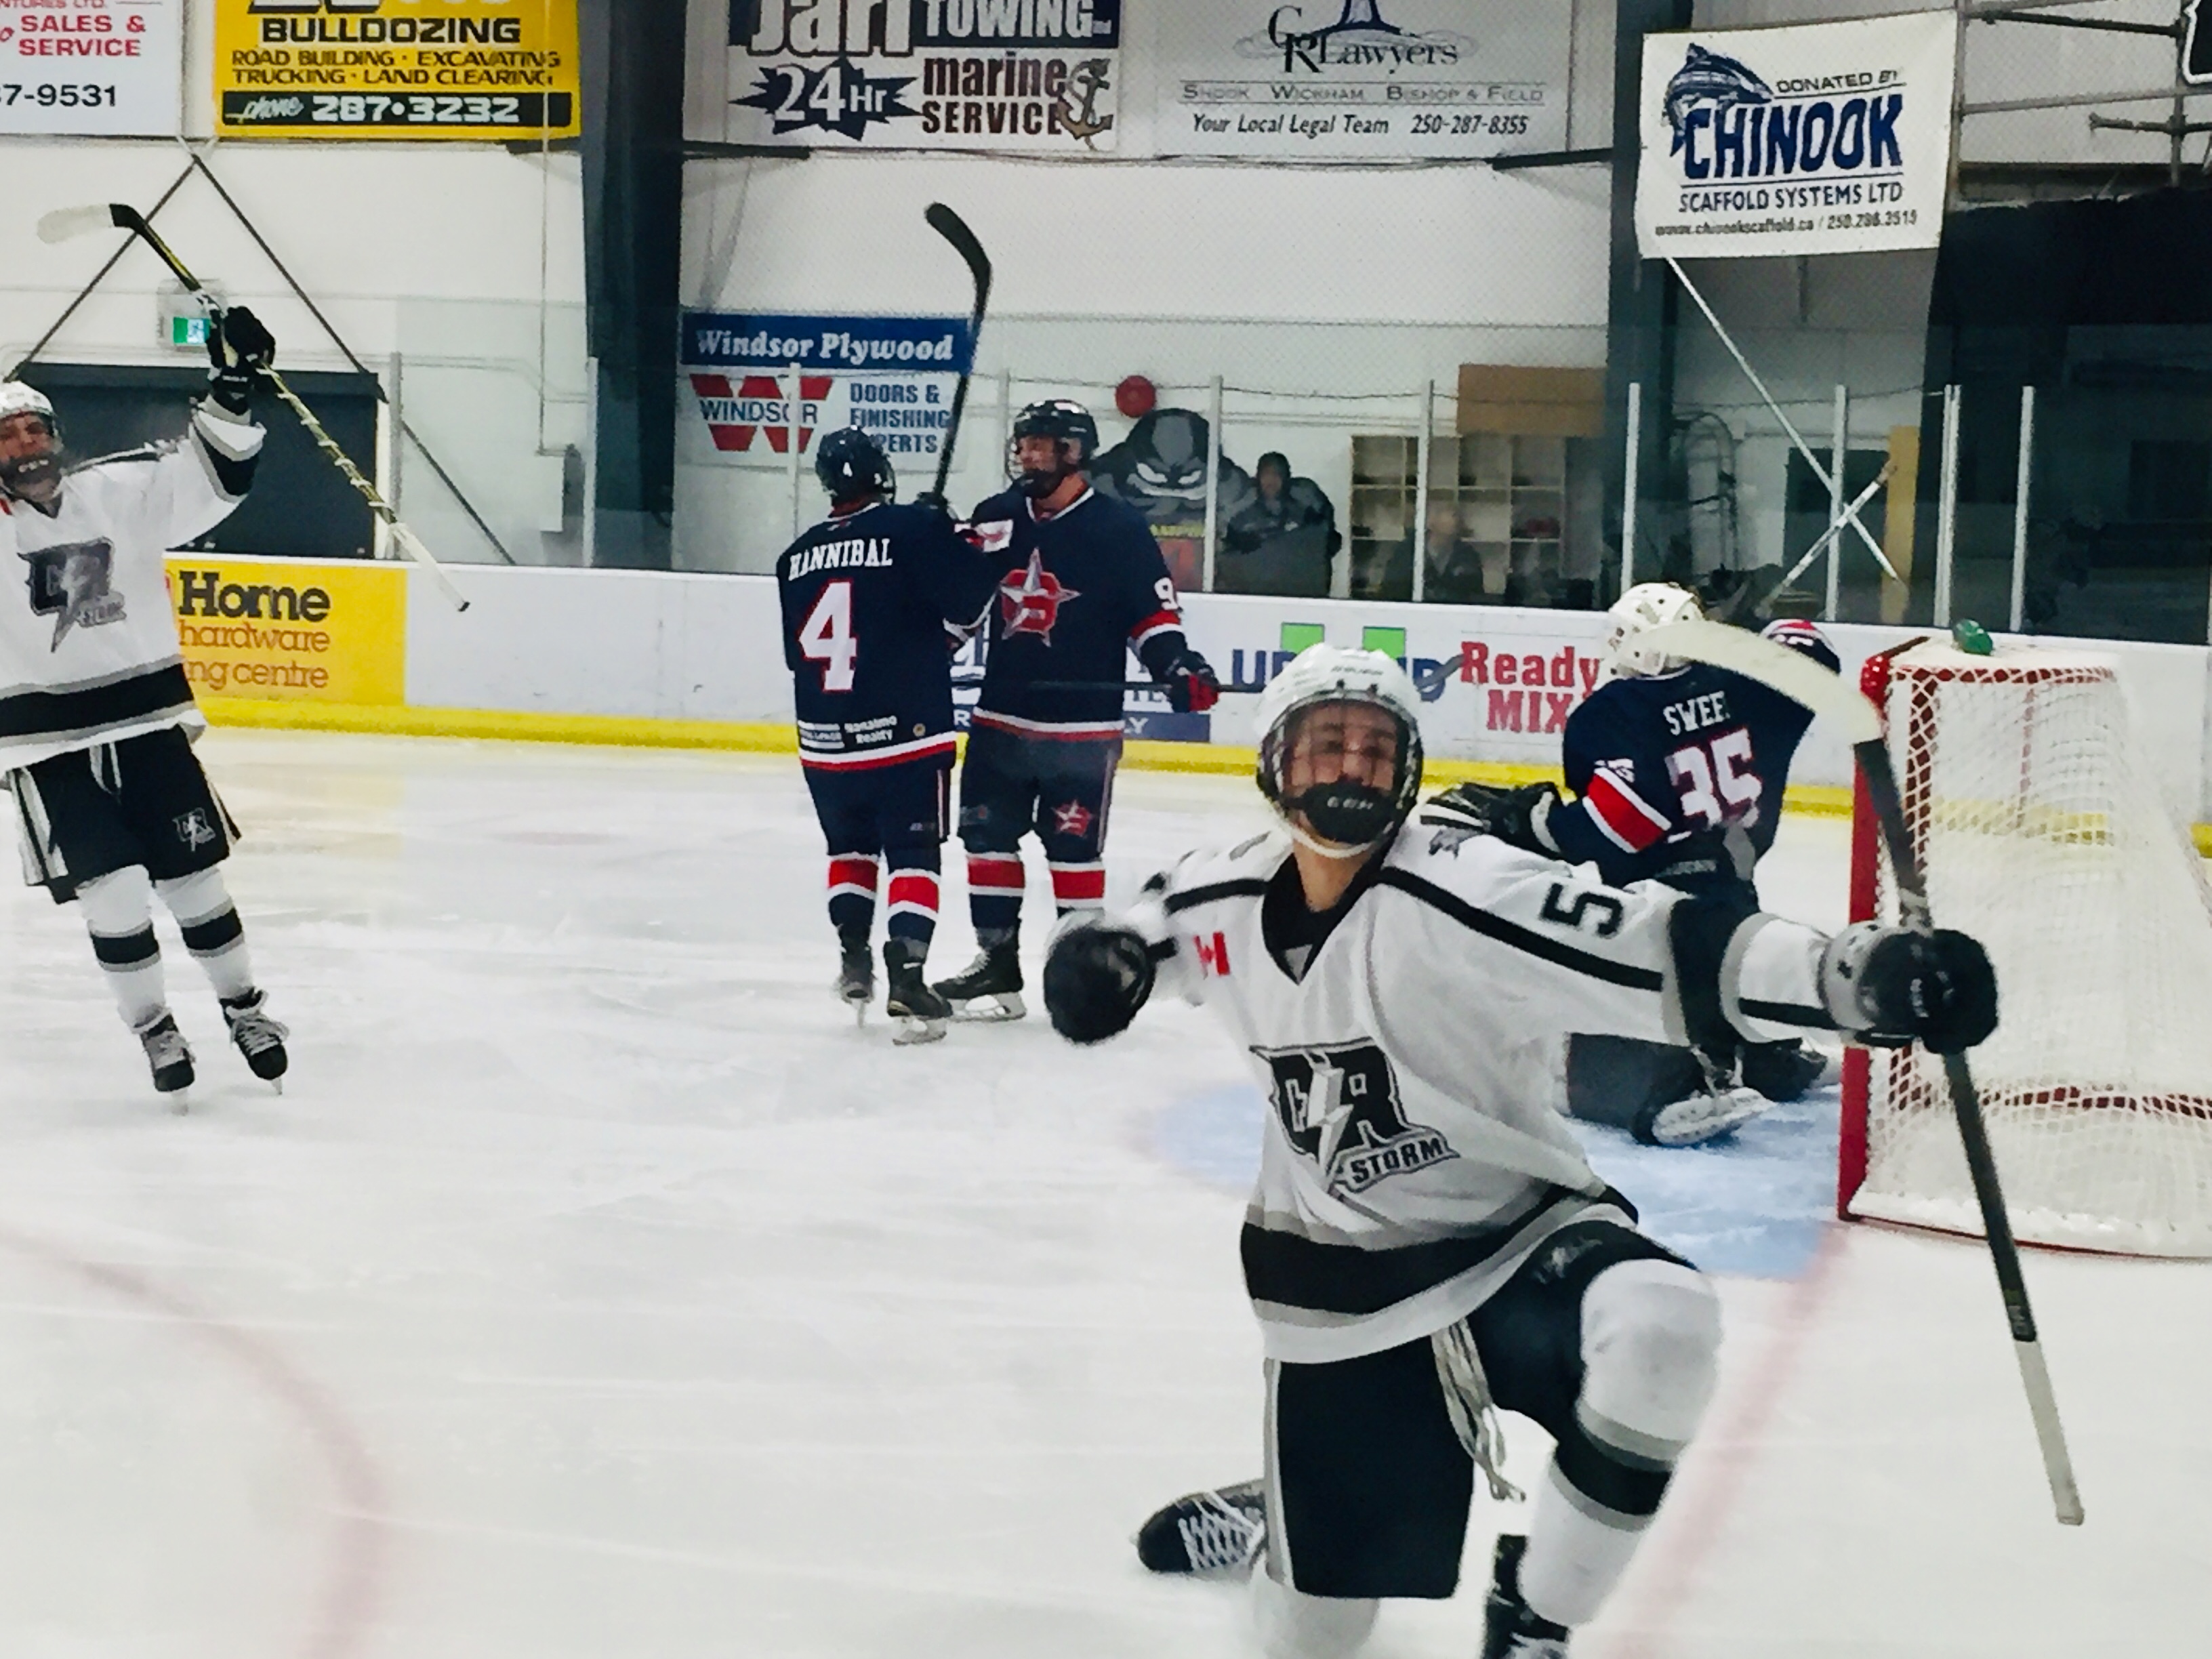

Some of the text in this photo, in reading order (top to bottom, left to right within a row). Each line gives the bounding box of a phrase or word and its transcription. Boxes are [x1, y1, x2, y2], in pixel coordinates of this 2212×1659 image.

[20, 15, 146, 33] SALES &
[262, 18, 520, 43] BULLDOZING
[18, 38, 142, 56] SERVICE
[232, 49, 560, 67] ROAD BUILDING EXCAVATING
[232, 68, 553, 85] TRUCKING LAND CLEARING
[922, 51, 1067, 98] marine
[1776, 72, 1872, 93] DONATED
[0, 83, 116, 107] 7-9531
[775, 65, 846, 121] 24
[922, 100, 1062, 135] SERVICE
[1193, 113, 1231, 131] Your
[1237, 114, 1284, 133] Local
[1289, 114, 1336, 139] Legal
[1343, 114, 1389, 134] Team
[1683, 94, 1904, 180] CHINOOK
[1678, 181, 1904, 213] SCAFFOLD SYSTEMS LTD
[696, 330, 954, 366] Windsor Plywood
[850, 382, 941, 404] DOORS &
[699, 400, 818, 424] WINDSR
[850, 409, 950, 429] FINISHING
[874, 434, 938, 453] PERTS
[787, 538, 893, 581] HANNIBAL
[178, 570, 331, 622] Home
[178, 619, 331, 653] hardware
[797, 579, 859, 693] 4
[232, 660, 329, 689] centre
[1460, 641, 1601, 698] Ready
[1486, 689, 1571, 733] MIX
[1663, 691, 1730, 736] SWEE
[1664, 726, 1763, 830] 35
[1540, 882, 1624, 939] 5
[1349, 1137, 1444, 1183] STORM
